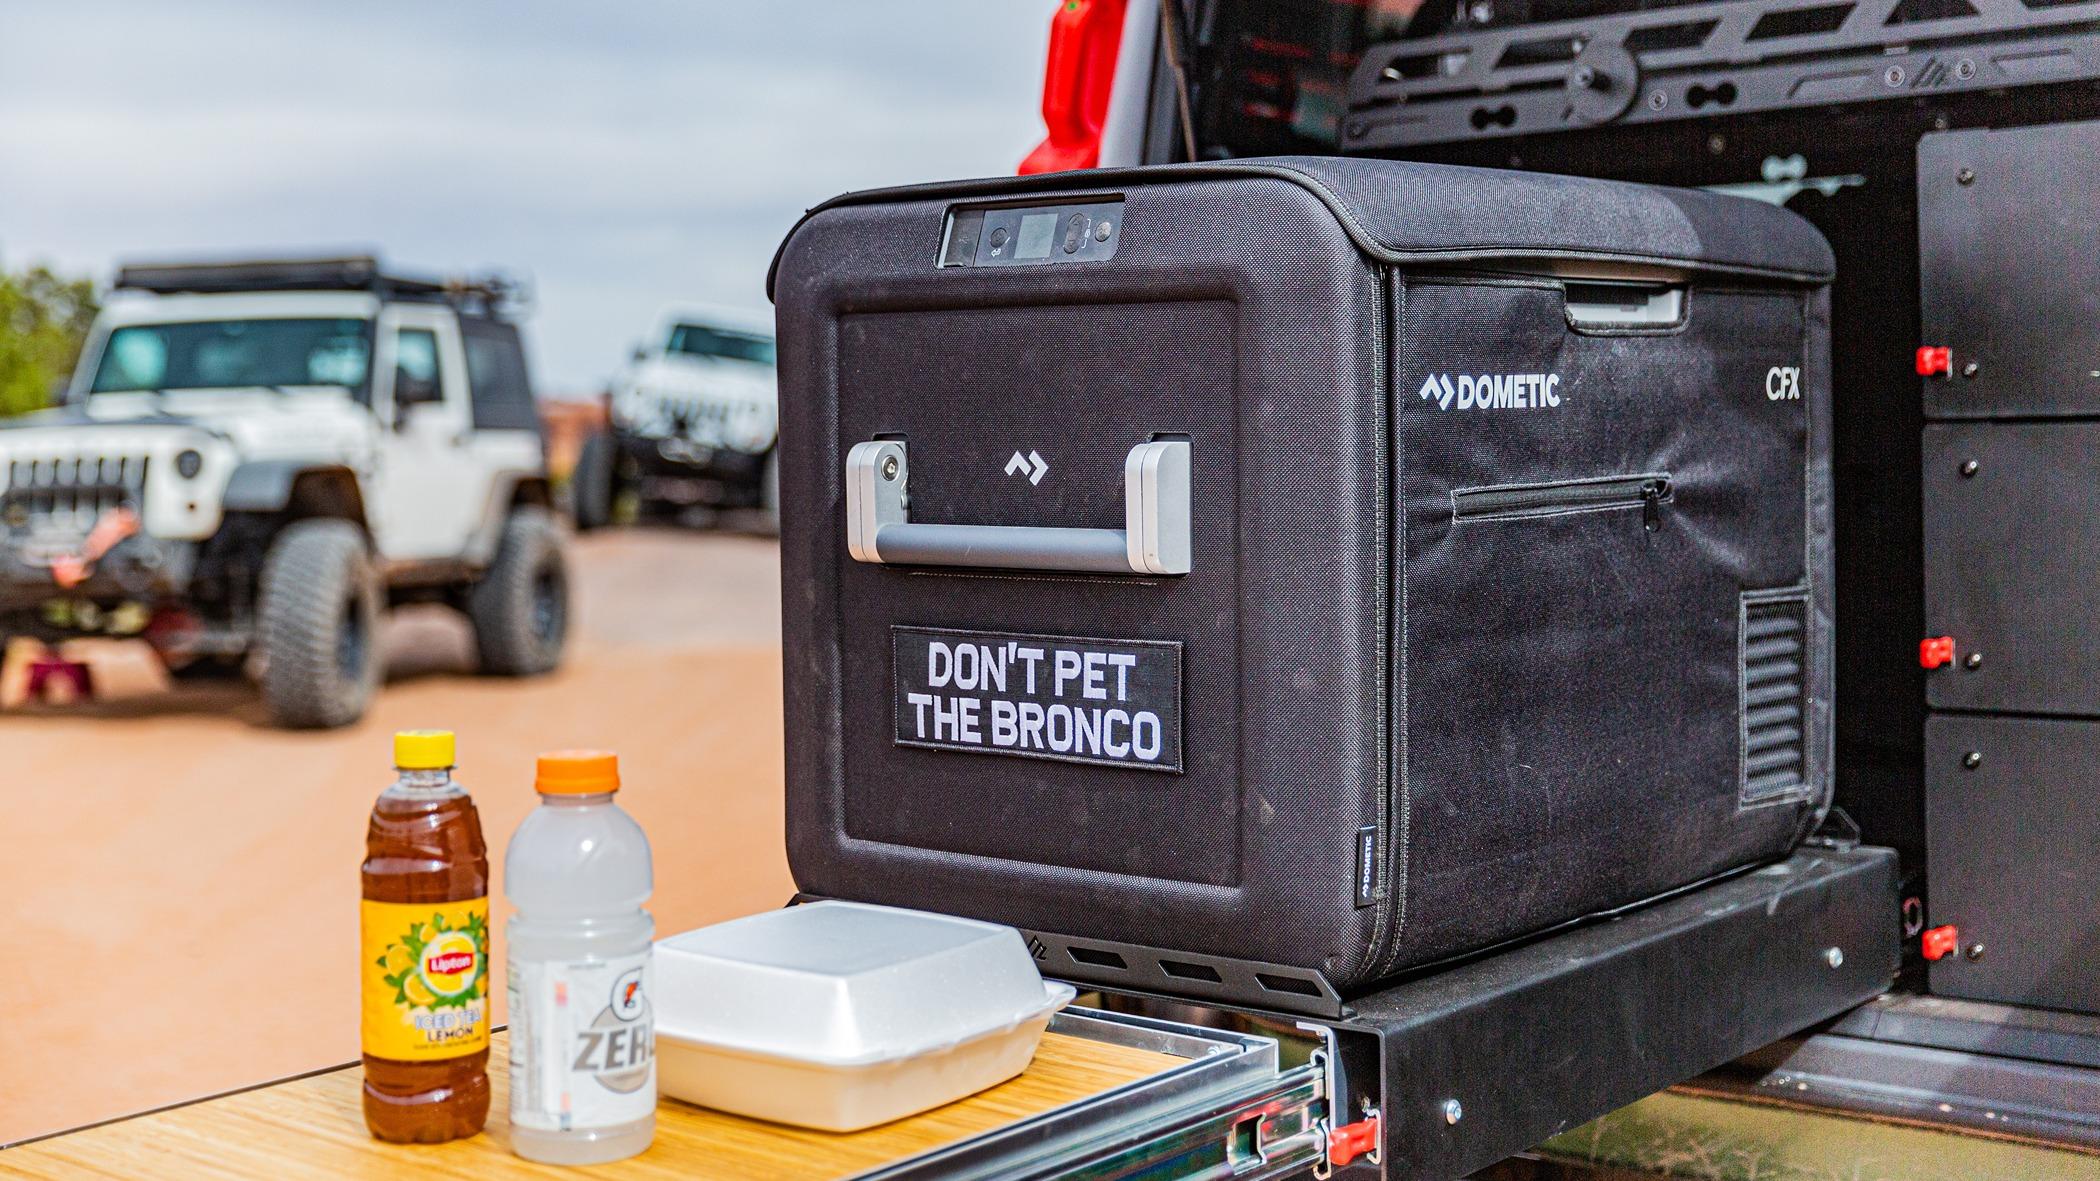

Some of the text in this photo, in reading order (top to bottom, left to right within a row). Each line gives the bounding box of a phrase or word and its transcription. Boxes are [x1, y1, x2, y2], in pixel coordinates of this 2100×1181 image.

[1457, 373, 1561, 410] DOMETIC
[1766, 366, 1801, 401] CFX
[928, 641, 1136, 701] DON'T PET
[907, 692, 1161, 761] THE BRONCO
[1363, 835, 1372, 883] DOMETIC
[430, 956, 472, 973] Lipton
[415, 1013, 456, 1030] ICED
[428, 1027, 473, 1042] LEMON
[572, 1023, 655, 1073] ZER
